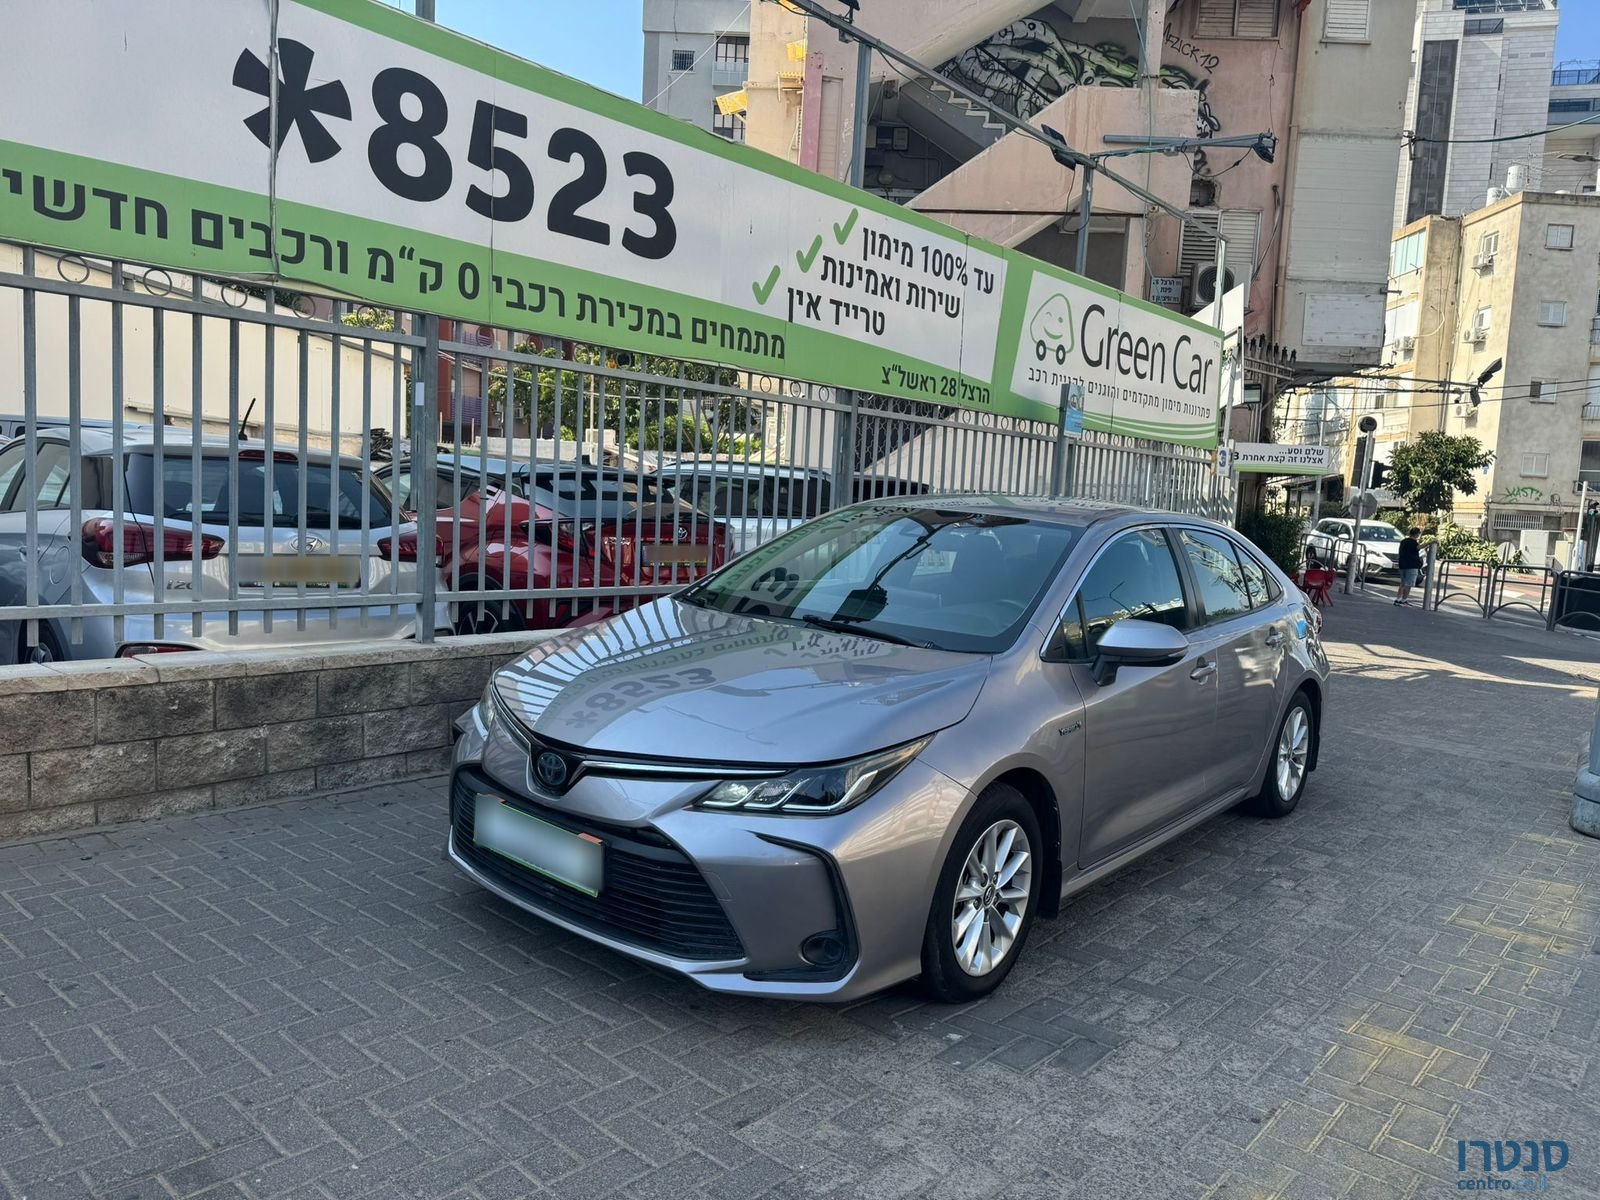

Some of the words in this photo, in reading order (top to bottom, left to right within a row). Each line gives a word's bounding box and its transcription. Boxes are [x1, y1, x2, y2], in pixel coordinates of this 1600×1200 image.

[192, 208, 349, 274] ורכבים
[863, 228, 913, 268] מימון
[367, 245, 443, 294] ק"מ
[458, 262, 480, 300] 0
[821, 255, 900, 302] ואמינות
[921, 245, 968, 287] 100%
[974, 267, 994, 294] עד
[492, 275, 565, 317] רכבי
[788, 287, 822, 323] אין
[906, 281, 960, 318] שירות
[576, 293, 682, 340] במכירת
[829, 298, 885, 335] טרייד
[692, 317, 785, 360] מתמחים
[1081, 304, 1166, 384] Green
[1173, 335, 1213, 395] Car
[940, 376, 957, 397] 28
[1028, 367, 1048, 383] רכב
[1088, 381, 1120, 400] והוגנים
[960, 378, 990, 405] הרצל
[1122, 390, 1159, 409] מתקדמים
[1161, 397, 1181, 413] מימון
[1183, 402, 1211, 419] פתרונות
[1242, 454, 1266, 462] אחרת
[1267, 455, 1286, 464] קצת
[1287, 455, 1298, 463] זה
[1300, 455, 1323, 464] אצלנו
[1305, 447, 1324, 456] שלם
